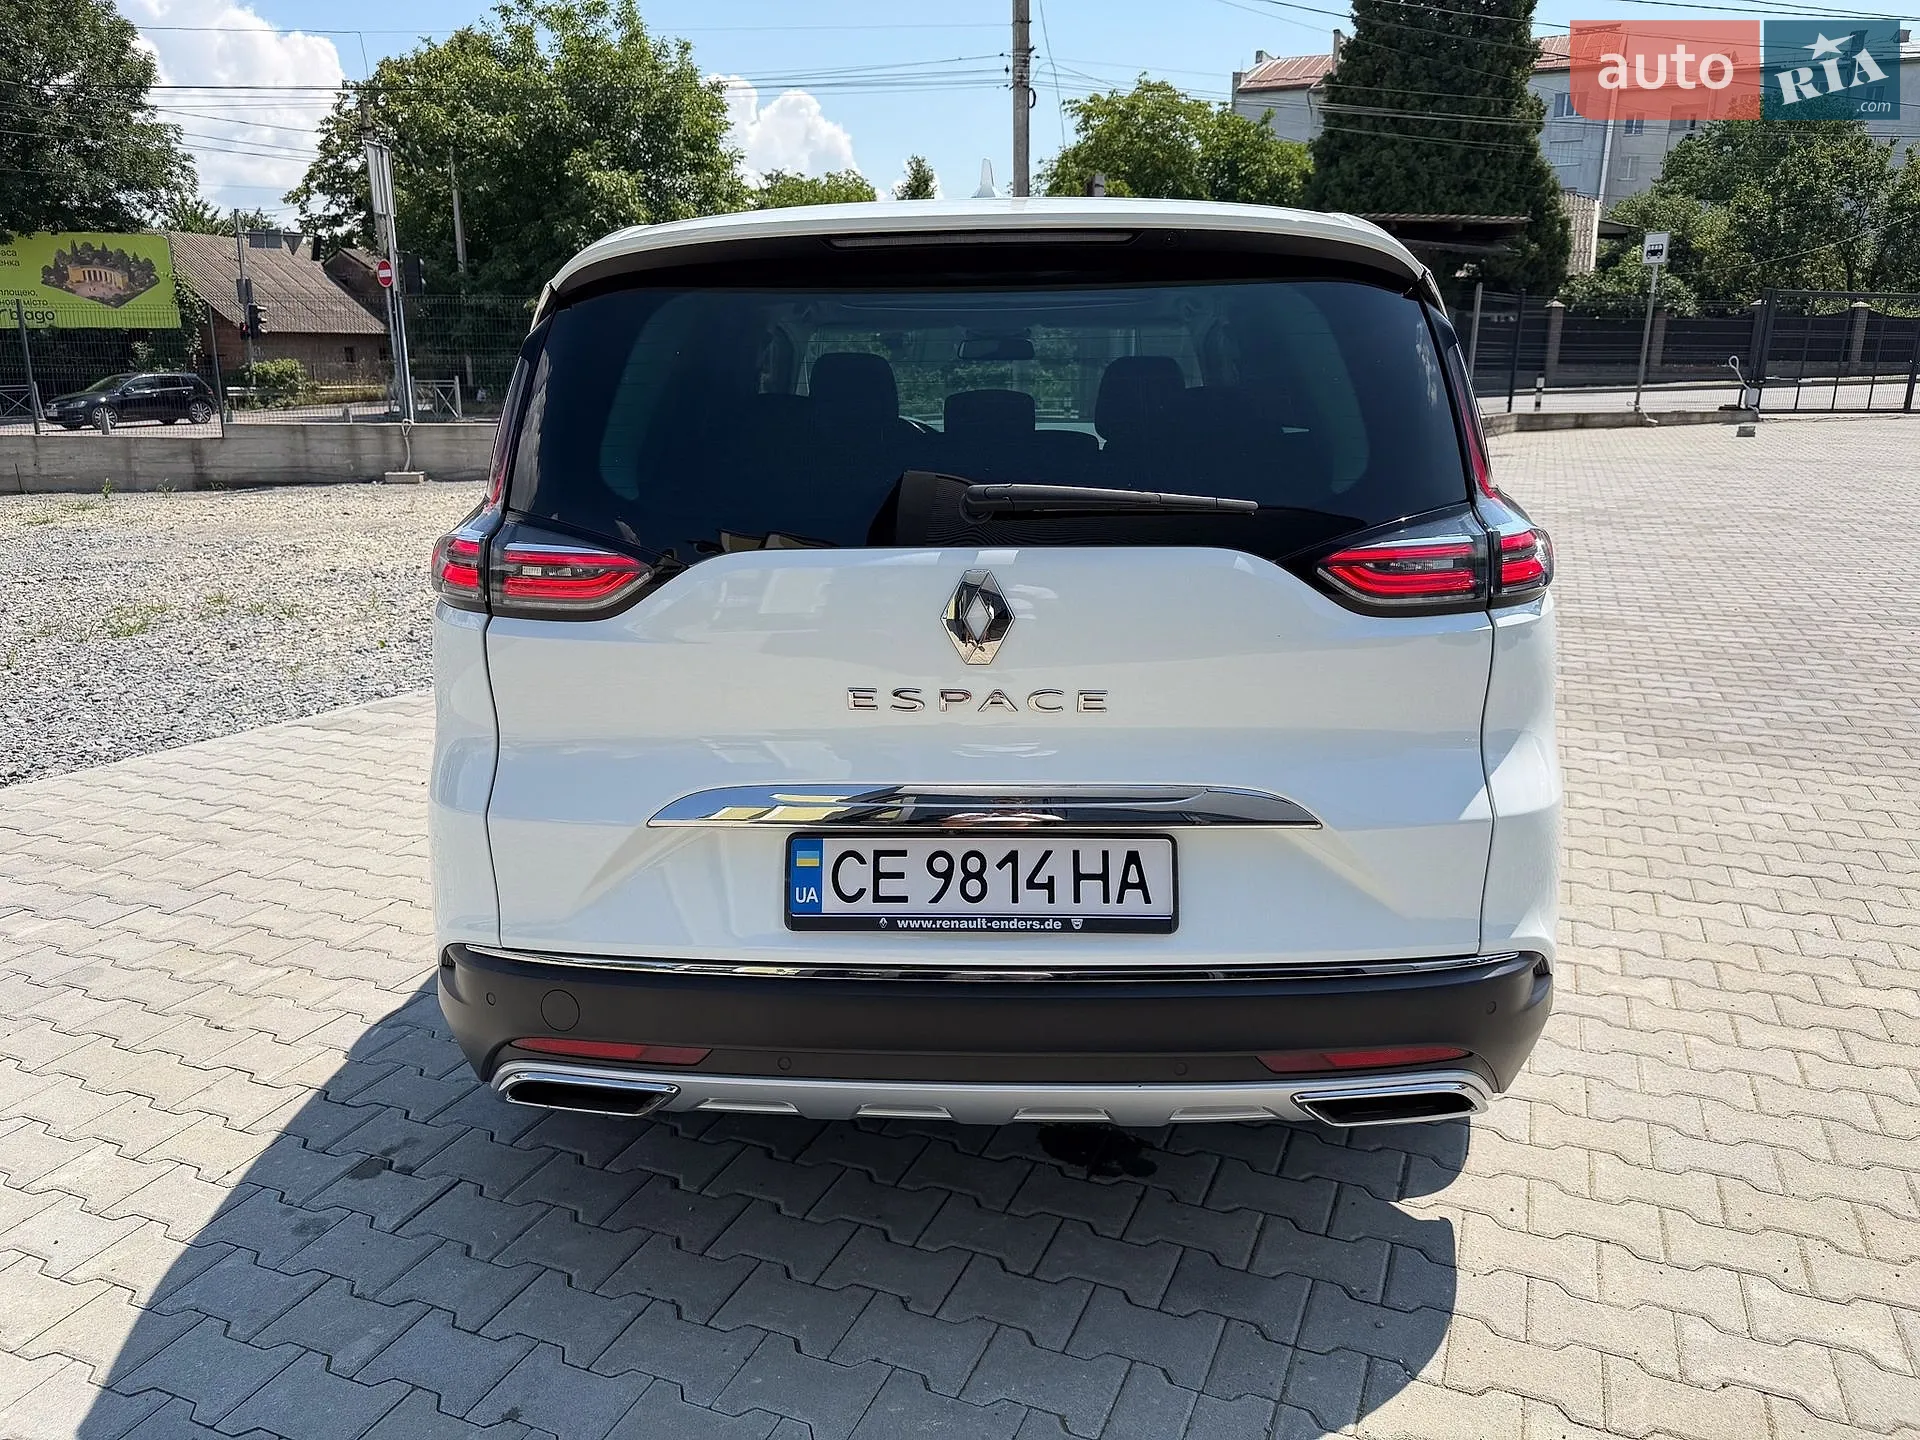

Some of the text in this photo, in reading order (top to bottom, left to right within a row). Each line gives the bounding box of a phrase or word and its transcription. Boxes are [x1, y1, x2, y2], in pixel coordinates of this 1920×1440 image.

[846, 686, 1109, 713] ESPACE
[831, 849, 1152, 905] CE 9814 HA
[795, 887, 819, 904] UA
[896, 917, 1063, 931] www.renault-enders.de
